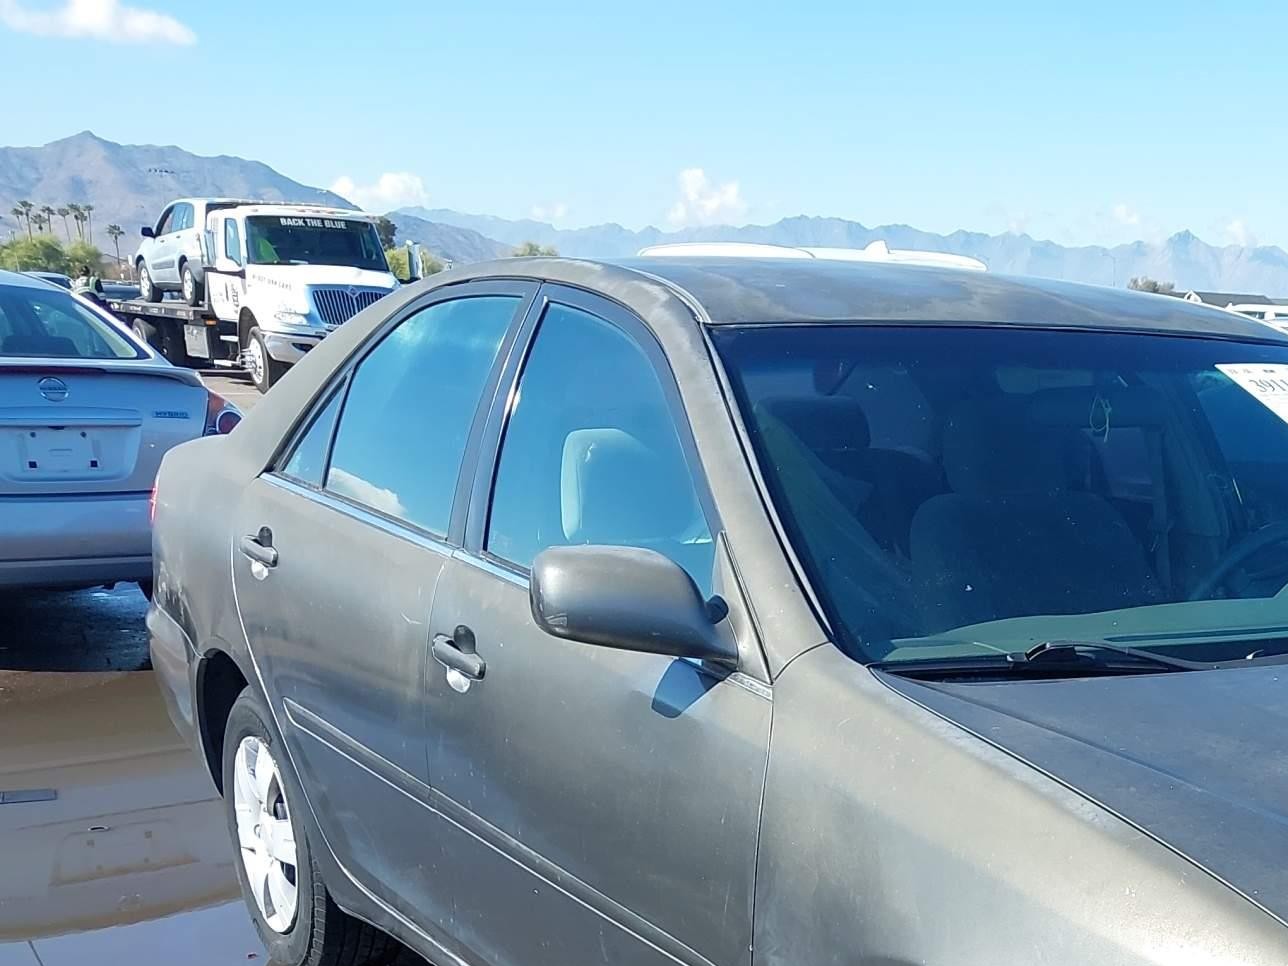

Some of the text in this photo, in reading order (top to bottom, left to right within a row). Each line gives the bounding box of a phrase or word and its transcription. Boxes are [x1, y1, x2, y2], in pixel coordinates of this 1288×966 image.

[280, 217, 347, 229] BACK THE BLUE
